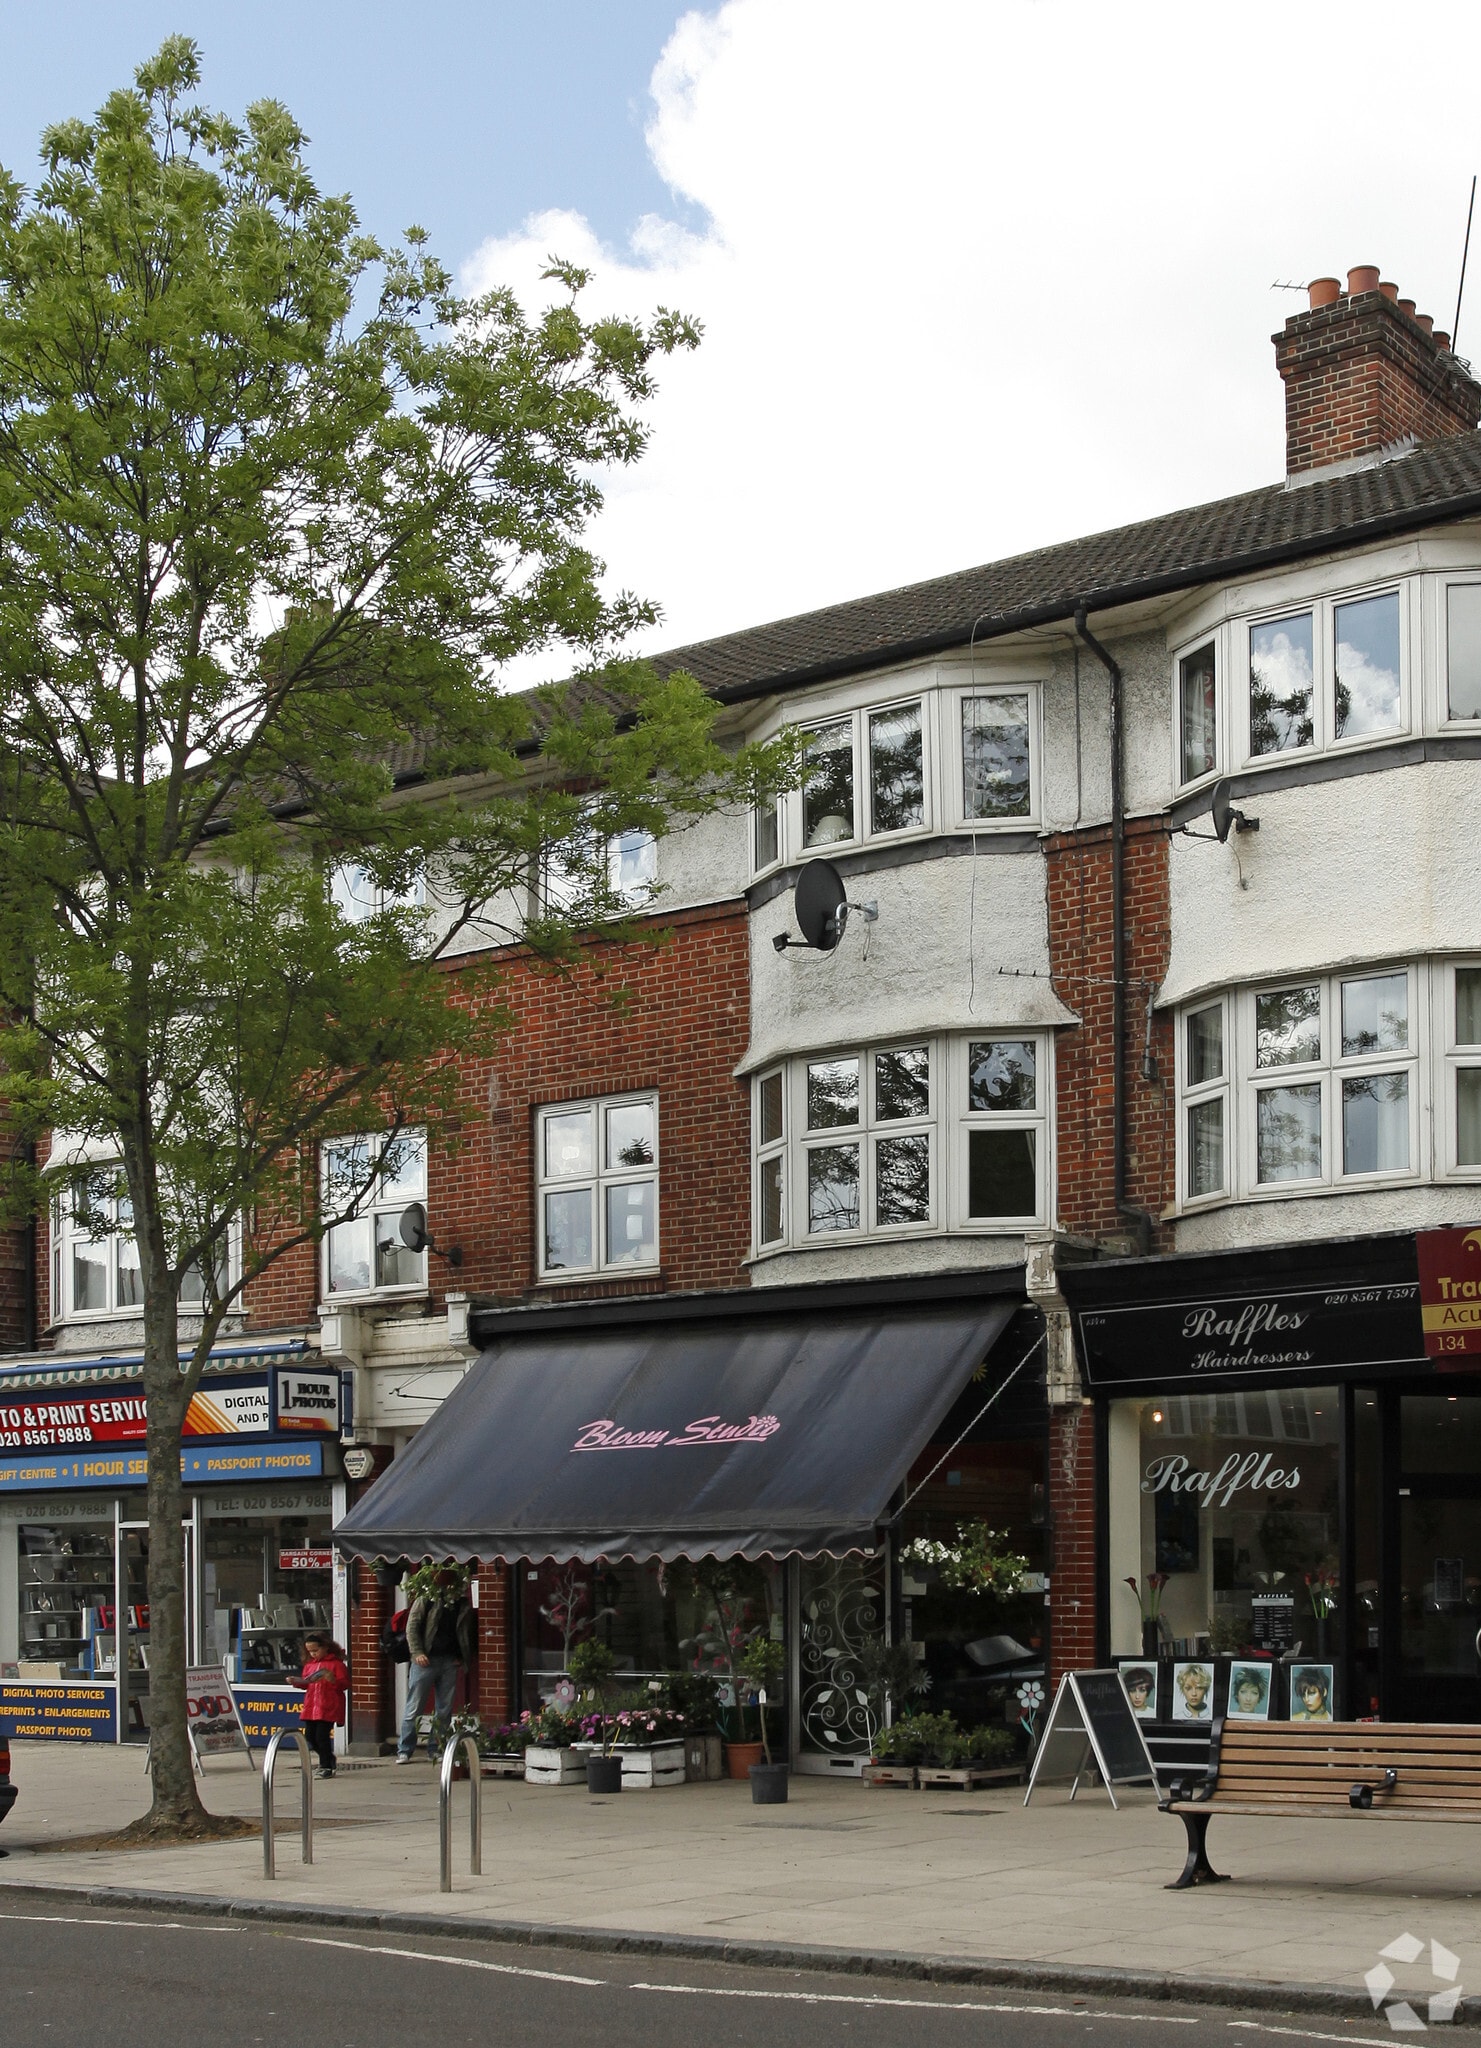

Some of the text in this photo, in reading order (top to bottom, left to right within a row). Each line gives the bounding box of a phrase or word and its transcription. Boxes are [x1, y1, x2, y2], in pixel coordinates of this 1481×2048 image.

[1324, 1287, 1417, 1305] 020 8567 7597
[1181, 1303, 1310, 1346] Raffles
[1437, 1335, 1467, 1351] 134
[1191, 1348, 1315, 1370] Hairdressers
[225, 1395, 269, 1409] DIGITAL
[281, 1380, 330, 1409] 1 HOUR
[291, 1396, 337, 1409] PHOTOS
[23, 1407, 37, 1427] &
[37, 1404, 86, 1427] PRINT
[237, 1413, 259, 1424] AND
[23, 1428, 57, 1446] 8567
[58, 1426, 92, 1443] 9888
[571, 1415, 781, 1449] Bloom Studio
[20, 1468, 57, 1479] CENTRE
[72, 1463, 79, 1477] 1
[83, 1461, 124, 1477] HOUR
[207, 1457, 262, 1471] PASSPORT
[265, 1454, 311, 1469] PHOTOS
[1140, 1452, 1301, 1508] Raffles
[26, 1506, 46, 1517] 020
[48, 1505, 75, 1517] 8567
[215, 1495, 332, 1511] TEL: 020 8567 988
[291, 1557, 320, 1567] 50%
[3, 1688, 105, 1700] DIGITAL PHOTO SERVICES
[44, 1707, 111, 1719] ENLARGEMENTS
[187, 1695, 233, 1717] DVD
[247, 1701, 276, 1713] PRINT
[16, 1725, 92, 1737] PASSPORT PHOTOS
